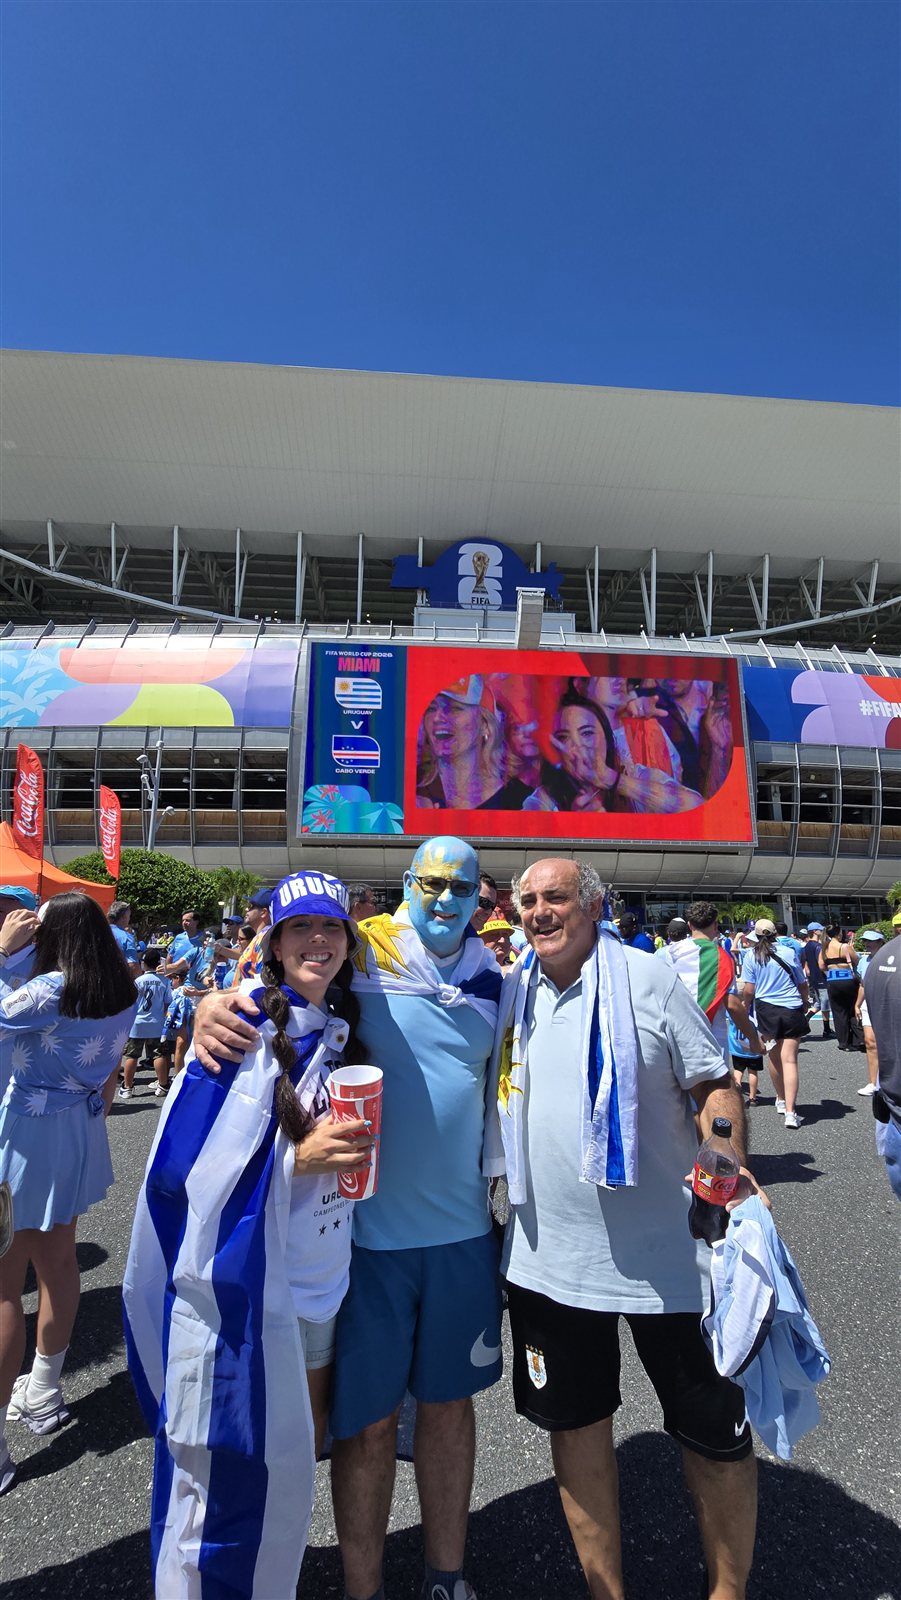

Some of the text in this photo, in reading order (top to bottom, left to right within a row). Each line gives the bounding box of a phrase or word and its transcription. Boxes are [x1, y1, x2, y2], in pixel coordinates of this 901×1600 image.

[471, 597, 490, 605] FIFA
[338, 657, 380, 672] MIAMI
[859, 700, 901, 717] #FIFA
